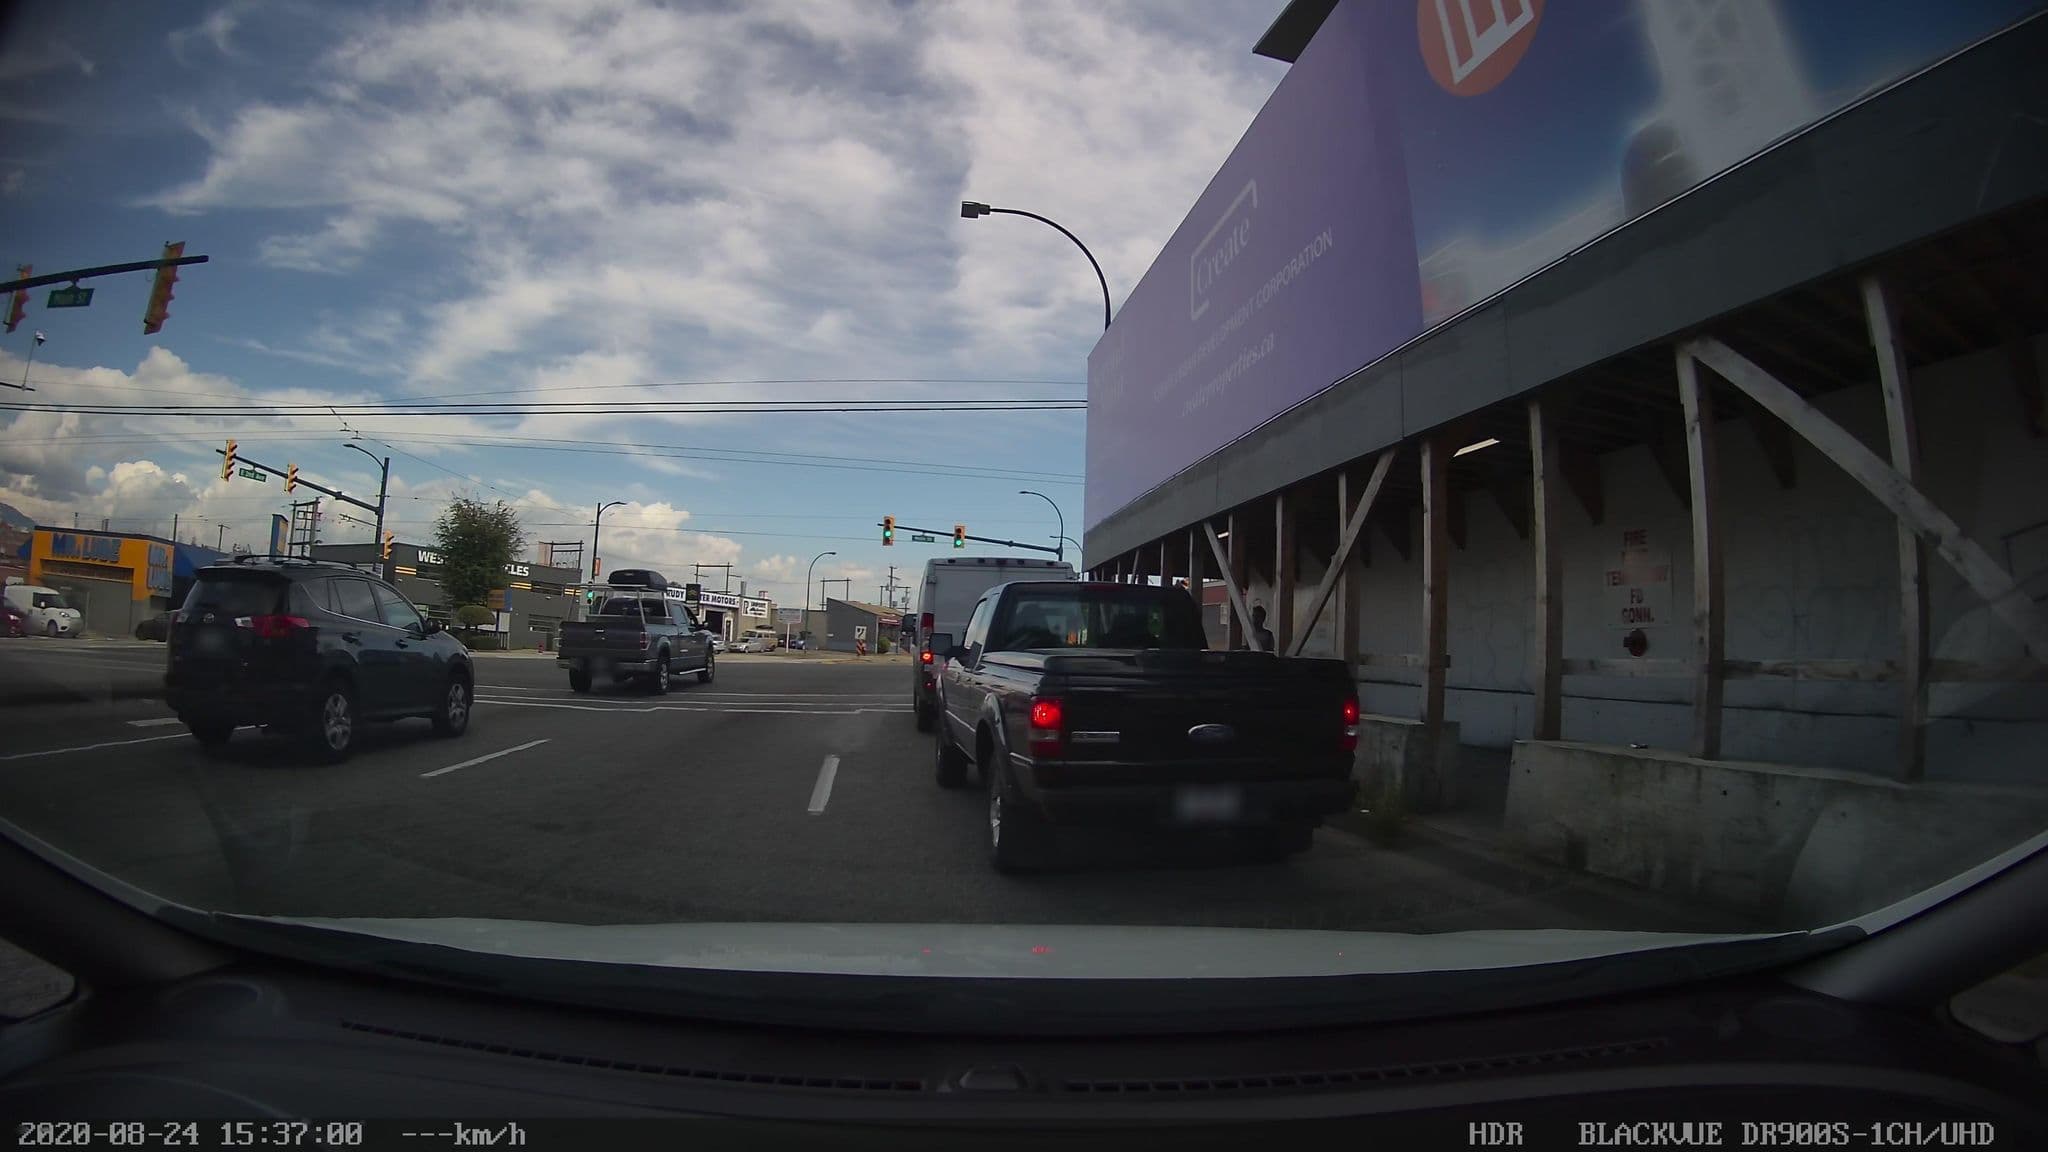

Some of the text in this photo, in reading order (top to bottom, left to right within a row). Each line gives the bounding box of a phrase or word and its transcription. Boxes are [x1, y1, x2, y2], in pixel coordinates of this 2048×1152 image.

[1197, 217, 1251, 296] Create
[1256, 226, 1334, 310] CORPORATION
[1623, 528, 1649, 545] FIRE
[711, 595, 736, 606] MOTORS
